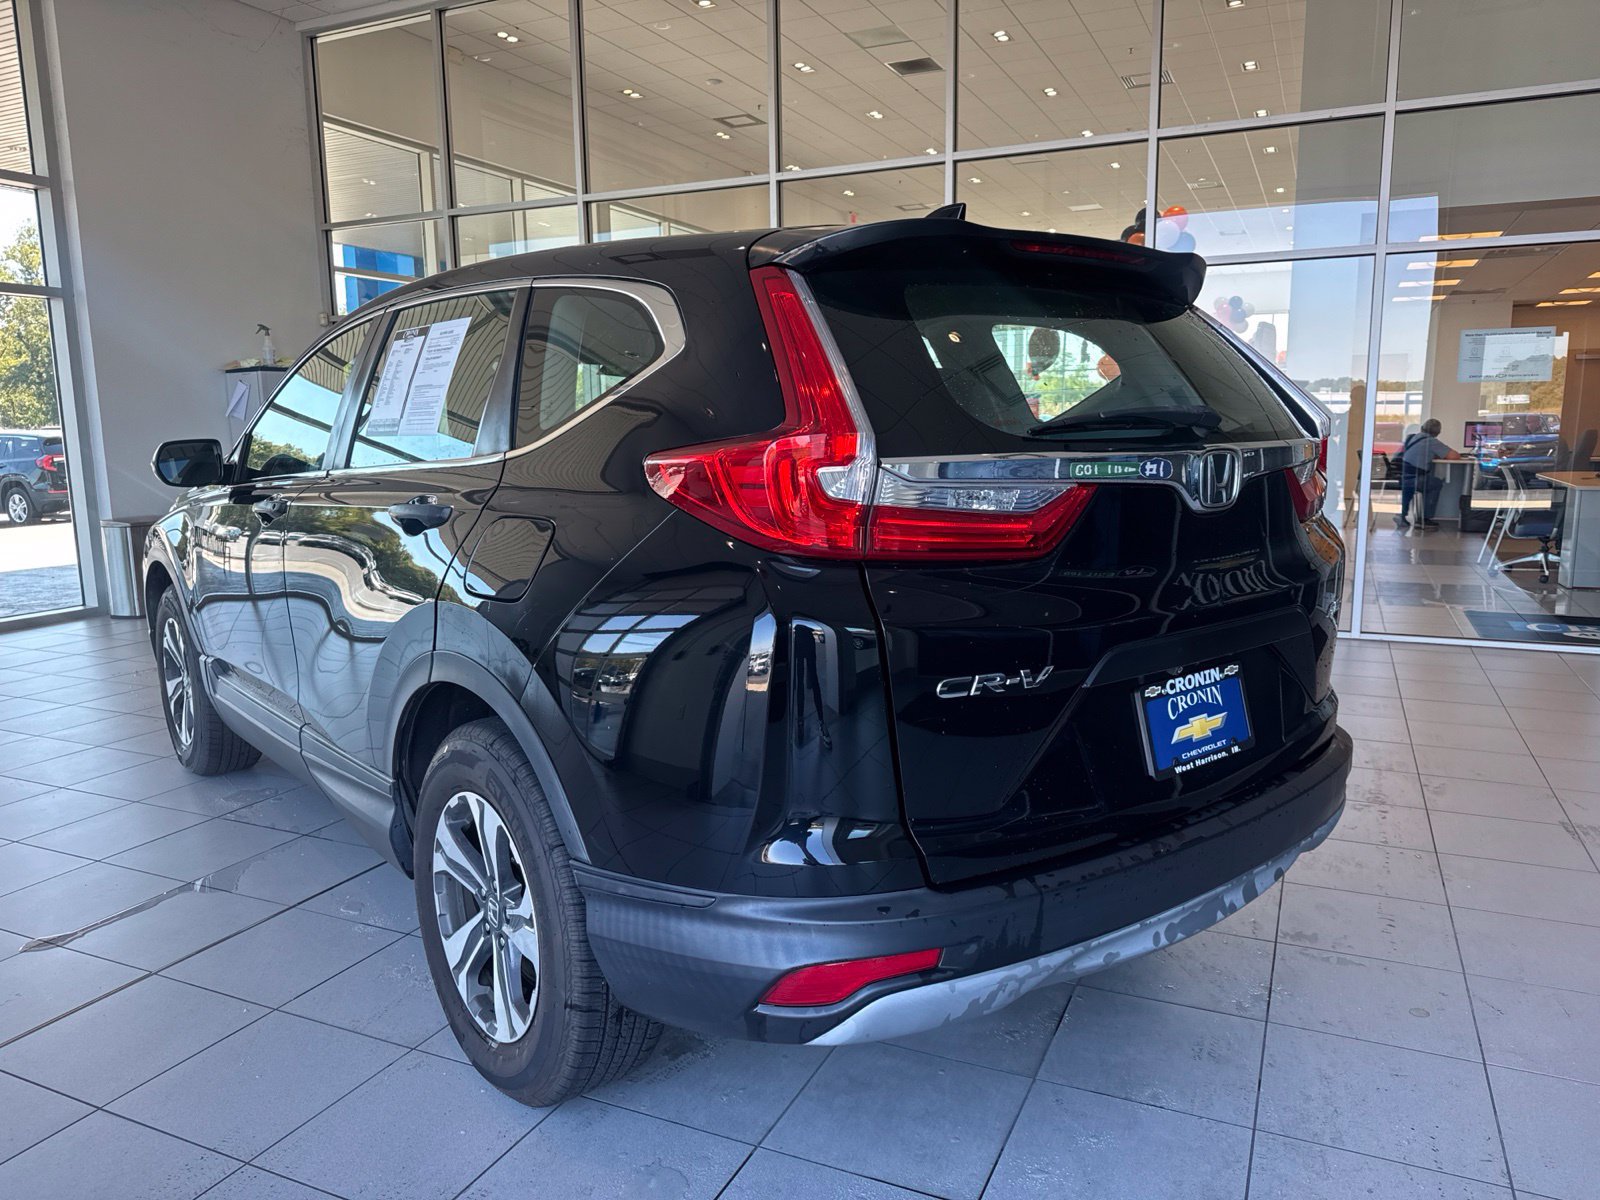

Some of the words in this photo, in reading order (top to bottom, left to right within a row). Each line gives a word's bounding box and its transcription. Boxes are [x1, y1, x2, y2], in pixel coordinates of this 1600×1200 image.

[936, 665, 1055, 699] CR-V
[1166, 667, 1221, 694] CRONIN
[1168, 685, 1223, 720] CRONIN
[1174, 763, 1194, 774] West
[1195, 750, 1229, 766] Harrison,
[1181, 739, 1227, 760] CHEVROLET
